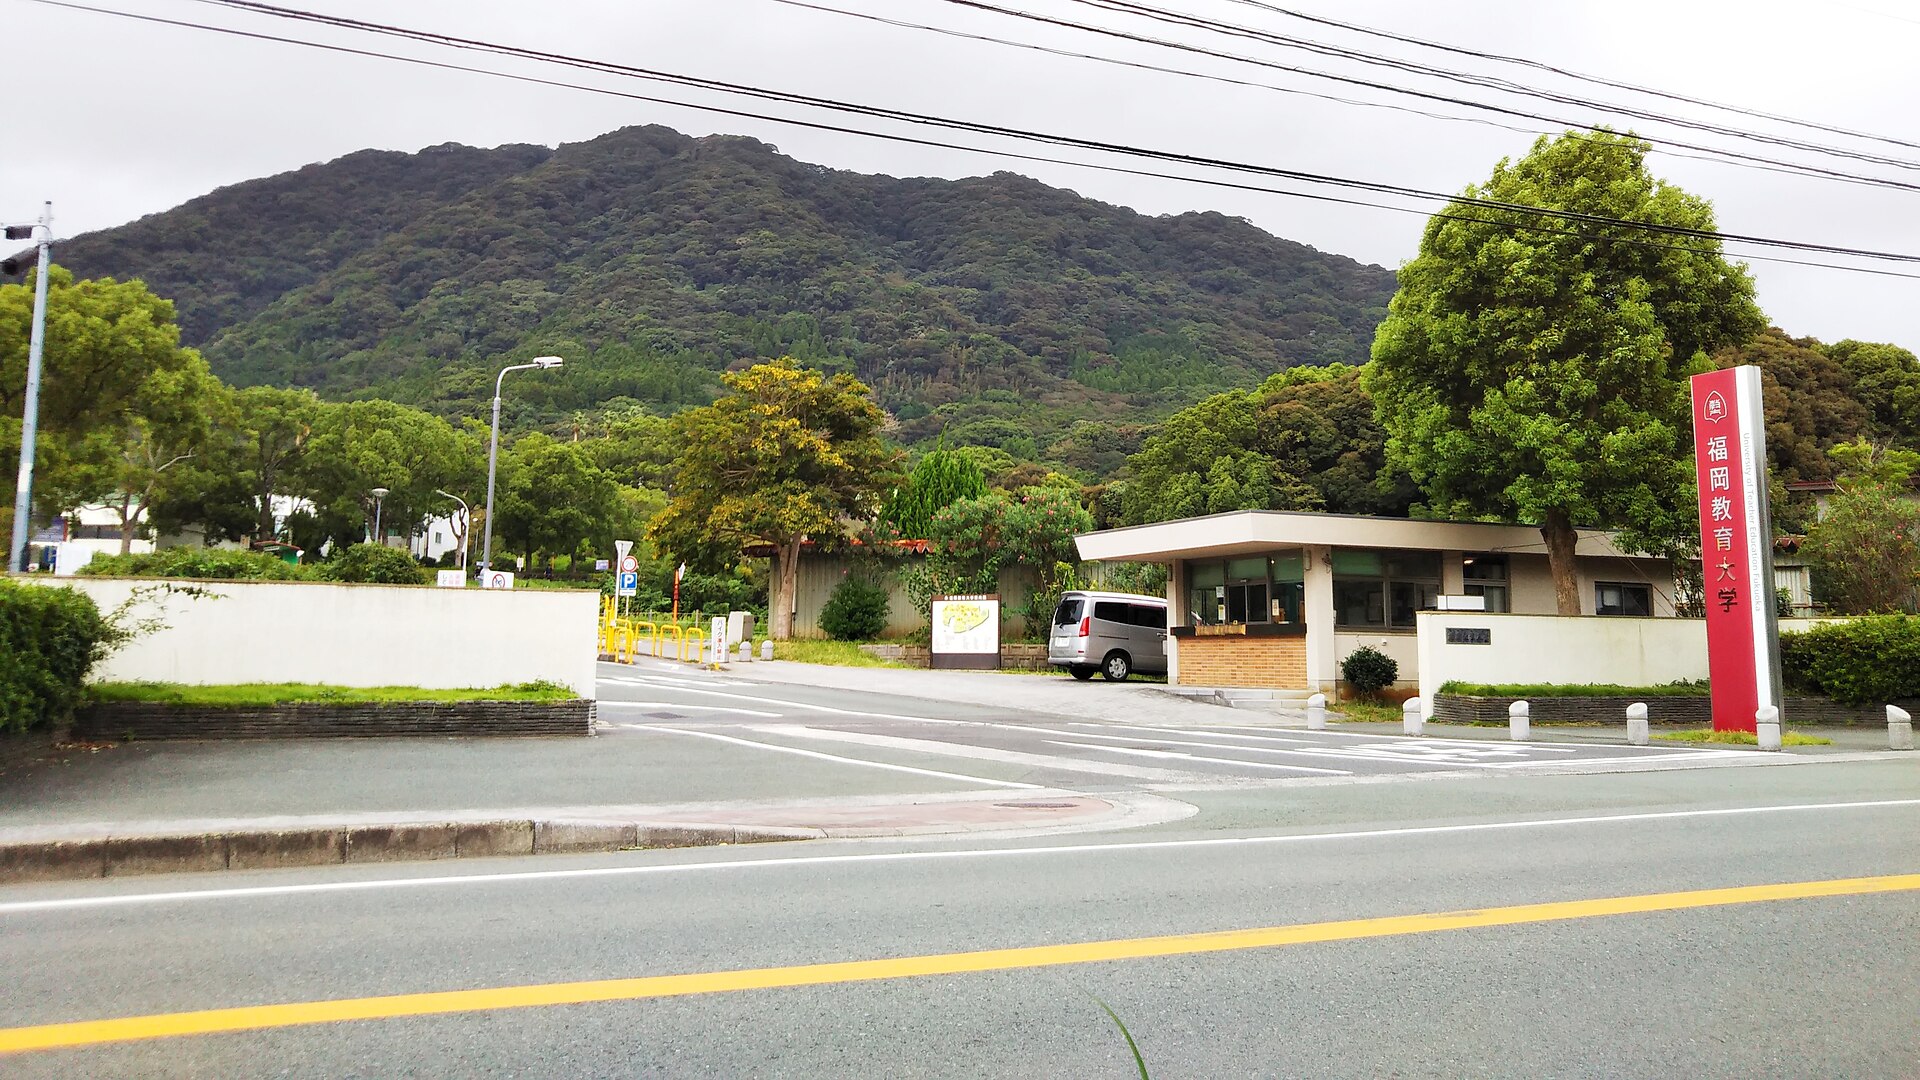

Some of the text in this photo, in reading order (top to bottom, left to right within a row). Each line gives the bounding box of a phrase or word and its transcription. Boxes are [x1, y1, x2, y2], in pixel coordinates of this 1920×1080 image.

[625, 574, 635, 588] P
[1707, 436, 1738, 613] 福岡教育大学
[1743, 432, 1762, 612] University of Teacher Education Fukuoka
